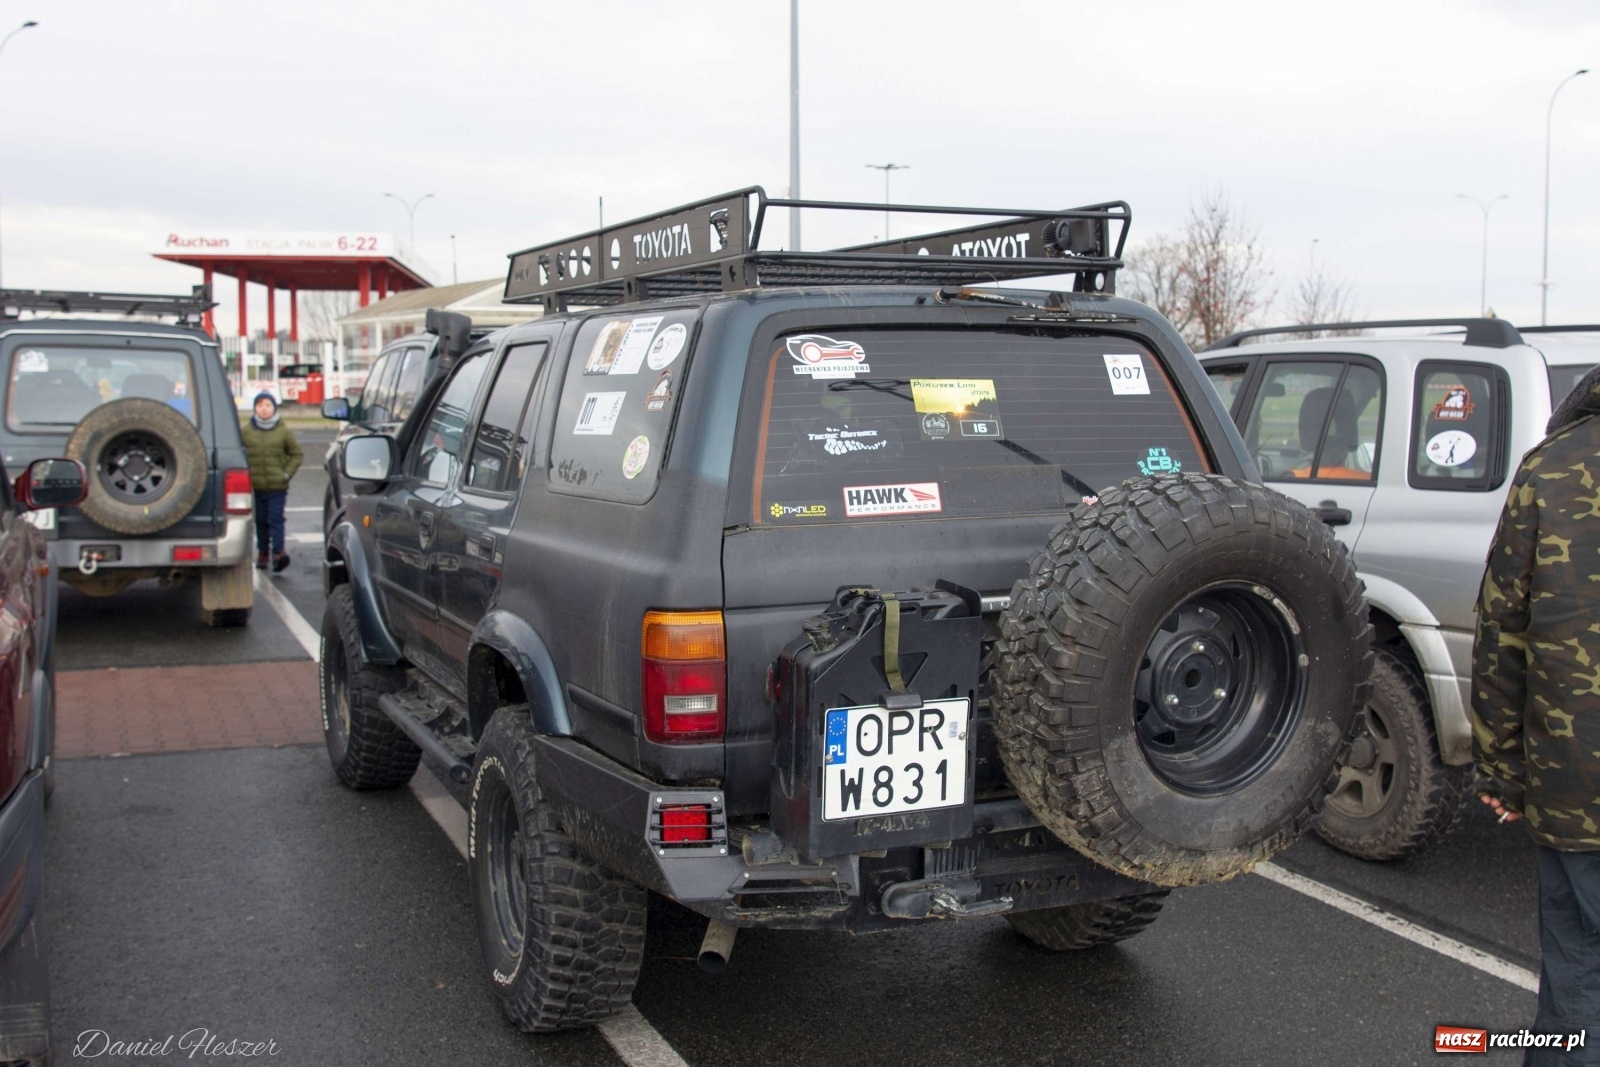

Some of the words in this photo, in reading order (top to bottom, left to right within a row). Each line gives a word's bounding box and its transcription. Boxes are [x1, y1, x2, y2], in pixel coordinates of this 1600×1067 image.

[166, 233, 229, 248] Auchan
[338, 236, 378, 251] 6-22
[633, 223, 692, 265] TOYOTA
[794, 365, 832, 373] MECHANIKA
[1112, 366, 1141, 380] 007
[973, 423, 988, 433] 16
[1146, 456, 1173, 471] CB
[847, 487, 908, 506] HAWK
[849, 503, 937, 512] PERFORMANCE
[856, 708, 946, 757] OPR
[829, 744, 845, 756] PL
[840, 759, 948, 812] W831
